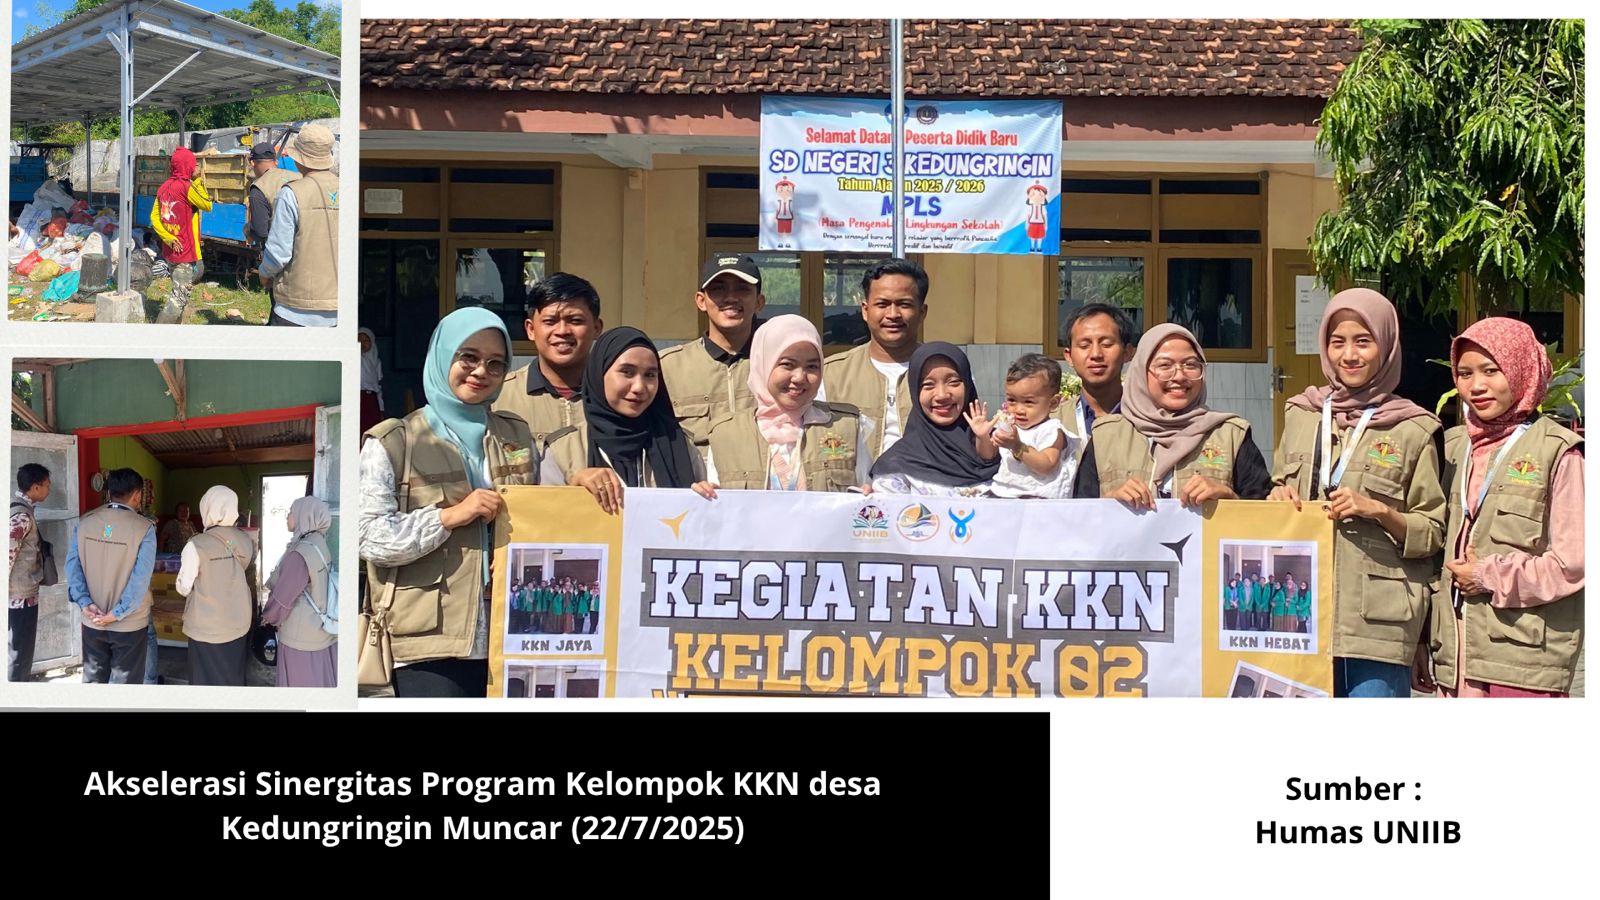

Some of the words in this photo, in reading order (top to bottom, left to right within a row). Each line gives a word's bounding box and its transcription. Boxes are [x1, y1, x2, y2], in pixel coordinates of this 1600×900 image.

[806, 127, 856, 144] Selamat
[905, 129, 953, 145] Peserta
[956, 130, 987, 146] Didik
[990, 130, 1018, 146] Baru
[769, 149, 800, 173] SD
[802, 149, 880, 176] NEGERI
[904, 152, 1053, 178] KEDUNGRINGIN
[838, 177, 874, 192] Tahun
[874, 178, 913, 194] Ajan
[914, 179, 943, 193] 2025
[944, 179, 955, 193] /
[955, 179, 985, 193] 2026
[881, 195, 942, 216] MPLS
[849, 217, 893, 231] Pengenal
[905, 218, 958, 232] Lingkungan
[853, 530, 888, 538] UNIIB
[650, 557, 1003, 629] KEGIATAN
[1022, 568, 1170, 633] KKN
[521, 639, 550, 652] KKN
[555, 640, 593, 652] JAYA
[1229, 635, 1258, 649] KKN
[1264, 636, 1311, 651] HEBAT
[671, 632, 1036, 698] KELOMPOK
[1056, 643, 1146, 698] 02
